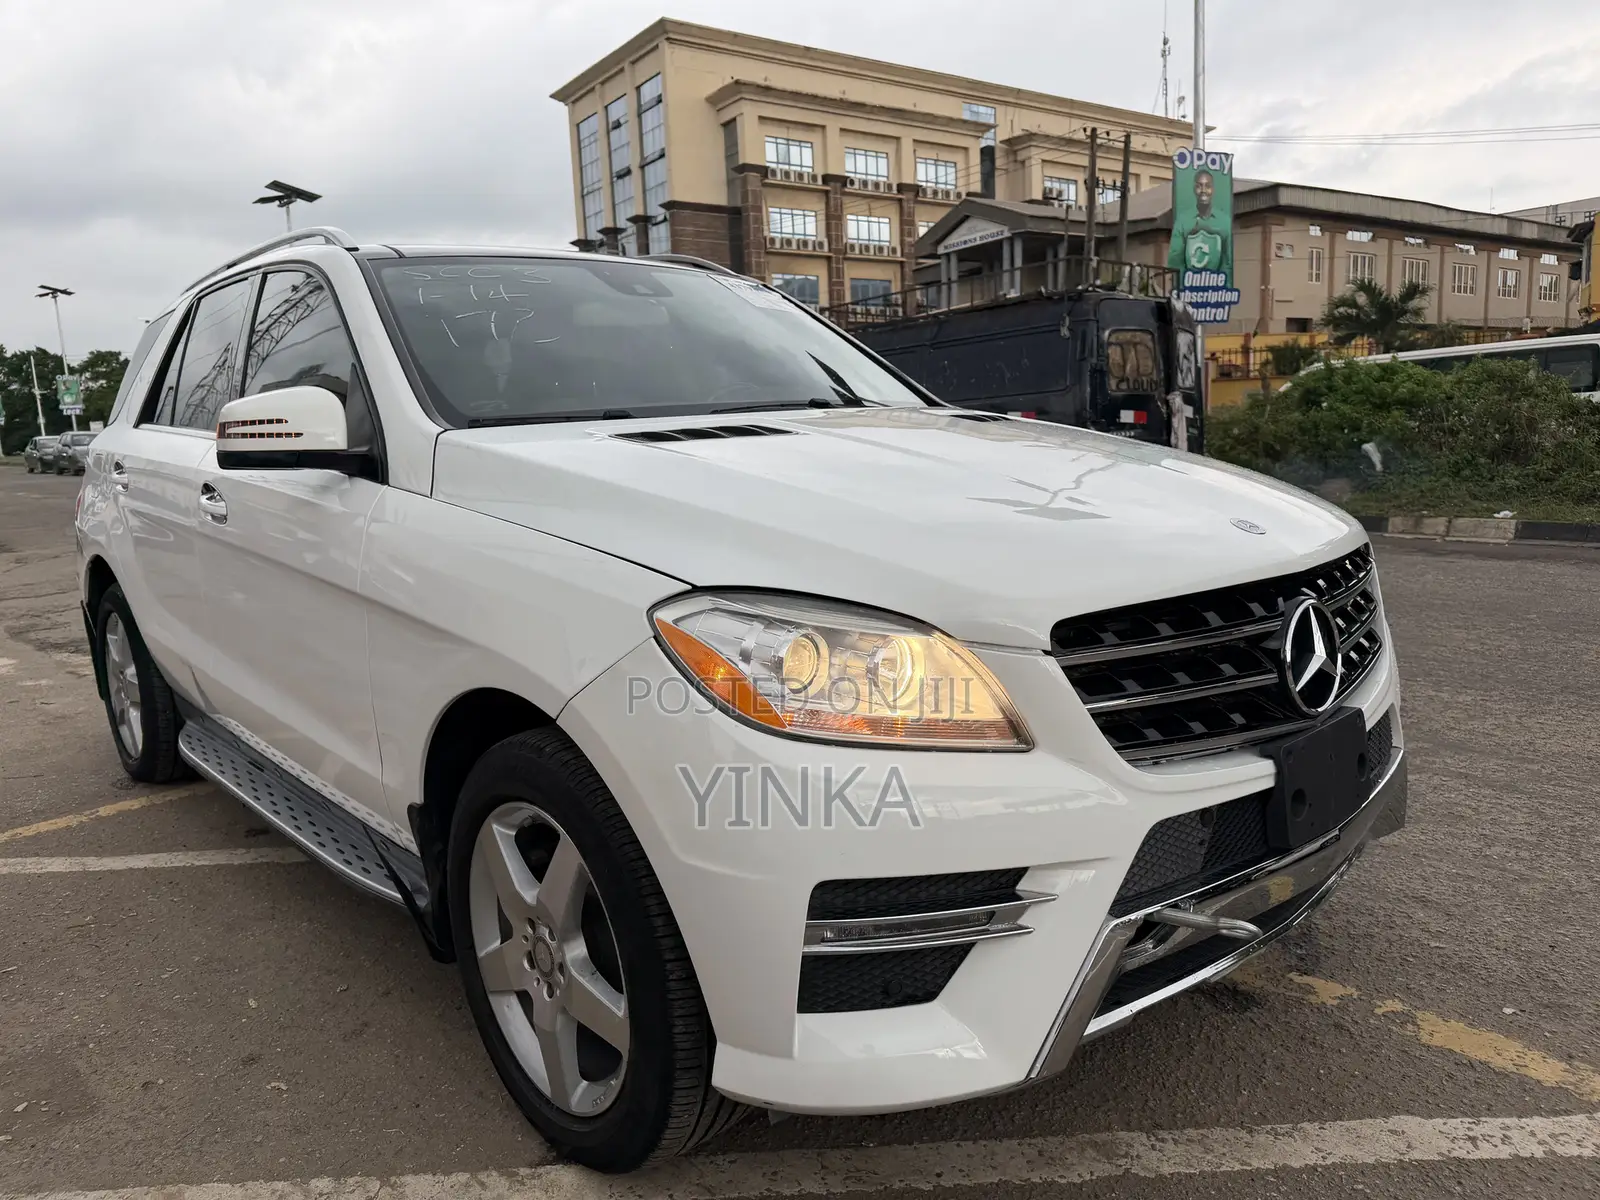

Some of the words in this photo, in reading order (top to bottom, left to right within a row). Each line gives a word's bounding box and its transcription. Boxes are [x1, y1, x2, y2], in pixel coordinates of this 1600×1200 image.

[1173, 146, 1234, 174] OPay
[943, 236, 977, 250] MISSIONS
[978, 229, 1005, 242] HOUSE
[1184, 271, 1226, 287] Online
